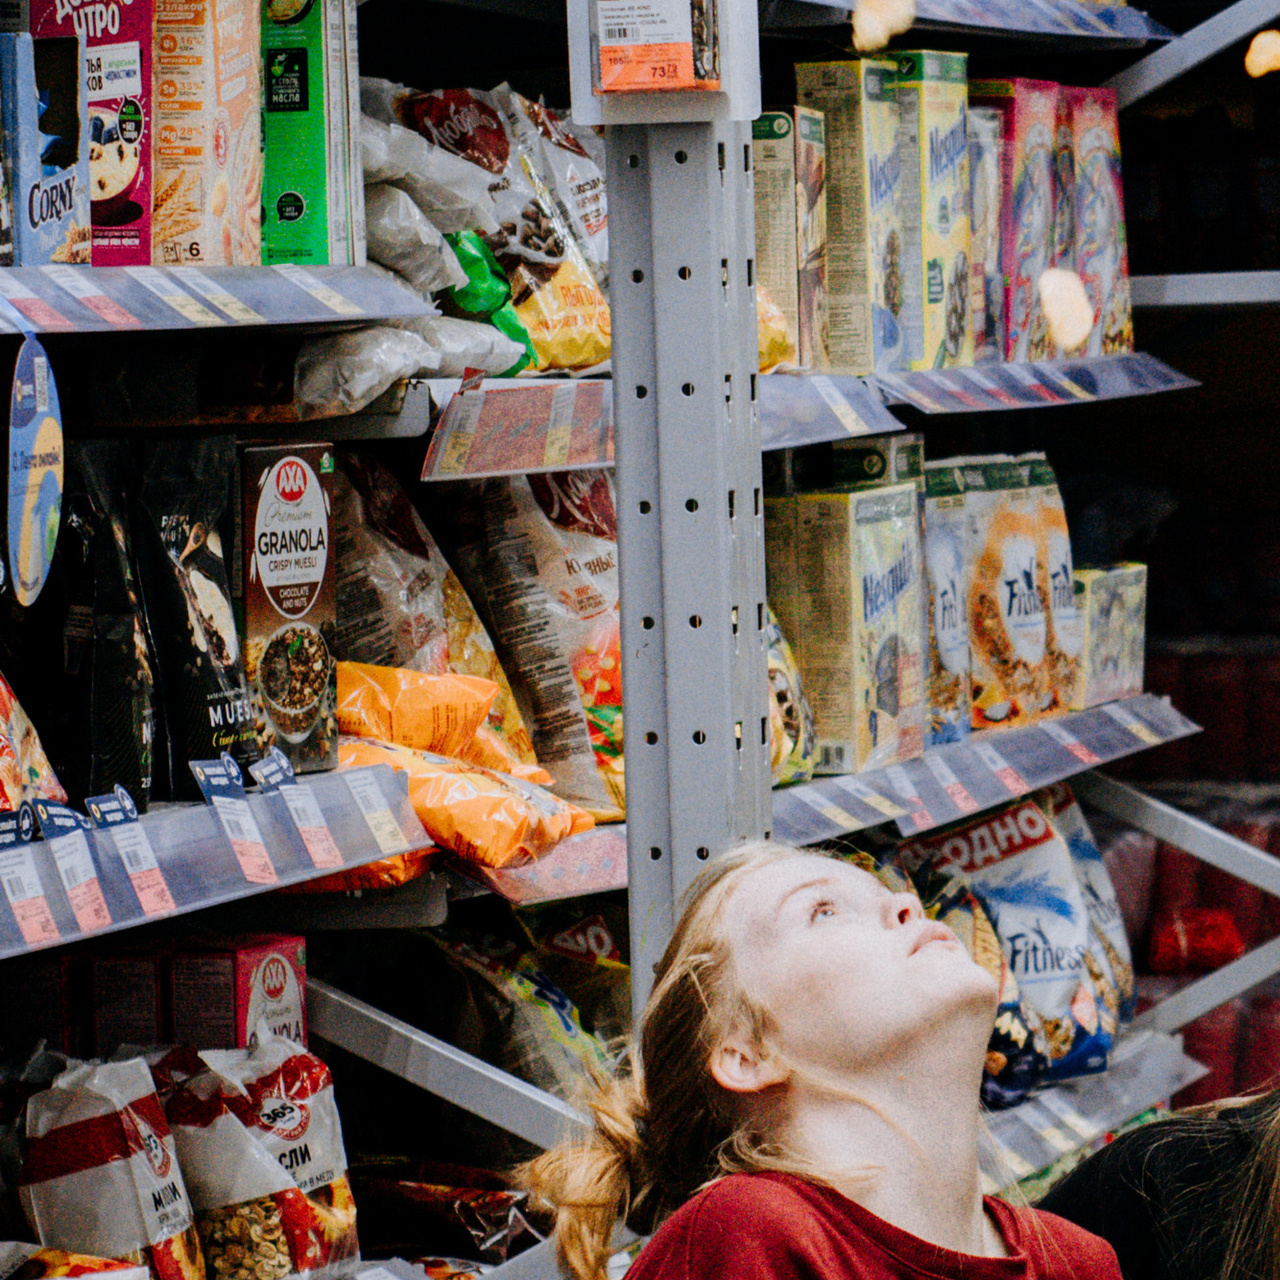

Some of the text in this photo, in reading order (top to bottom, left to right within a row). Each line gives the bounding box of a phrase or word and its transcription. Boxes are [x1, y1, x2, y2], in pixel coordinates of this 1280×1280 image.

[651, 66, 666, 78] 73
[161, 129, 176, 142] Mg
[28, 175, 75, 230] CORNY
[188, 241, 201, 258] 6
[279, 465, 305, 494] AXA
[258, 527, 326, 557] GRANOLA
[268, 557, 317, 572] CRISPY MUESLI
[279, 587, 310, 599] CHOCOLATE
[209, 699, 252, 728] MUES
[942, 807, 1047, 868] ОДНО
[1009, 921, 1087, 974] Fitness
[265, 962, 286, 992] AXA
[261, 1104, 295, 1126] 365
[278, 1144, 312, 1171] СЛИ
